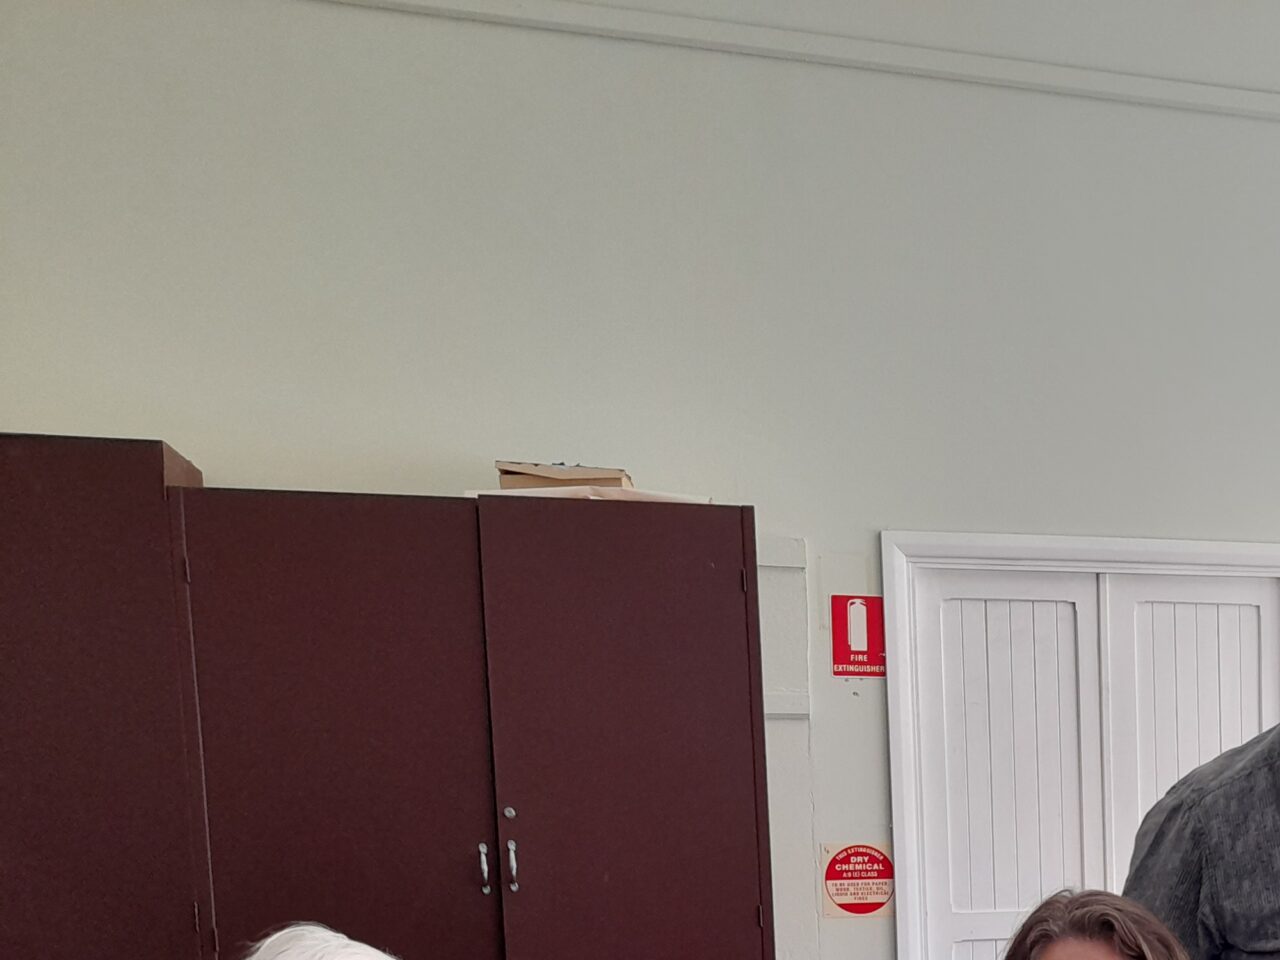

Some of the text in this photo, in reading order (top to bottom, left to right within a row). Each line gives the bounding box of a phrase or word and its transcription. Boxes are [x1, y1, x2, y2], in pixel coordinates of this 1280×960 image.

[850, 654, 868, 662] FIRE
[833, 664, 885, 673] EXTINGUISHER
[835, 863, 885, 871] CHEMICAL
